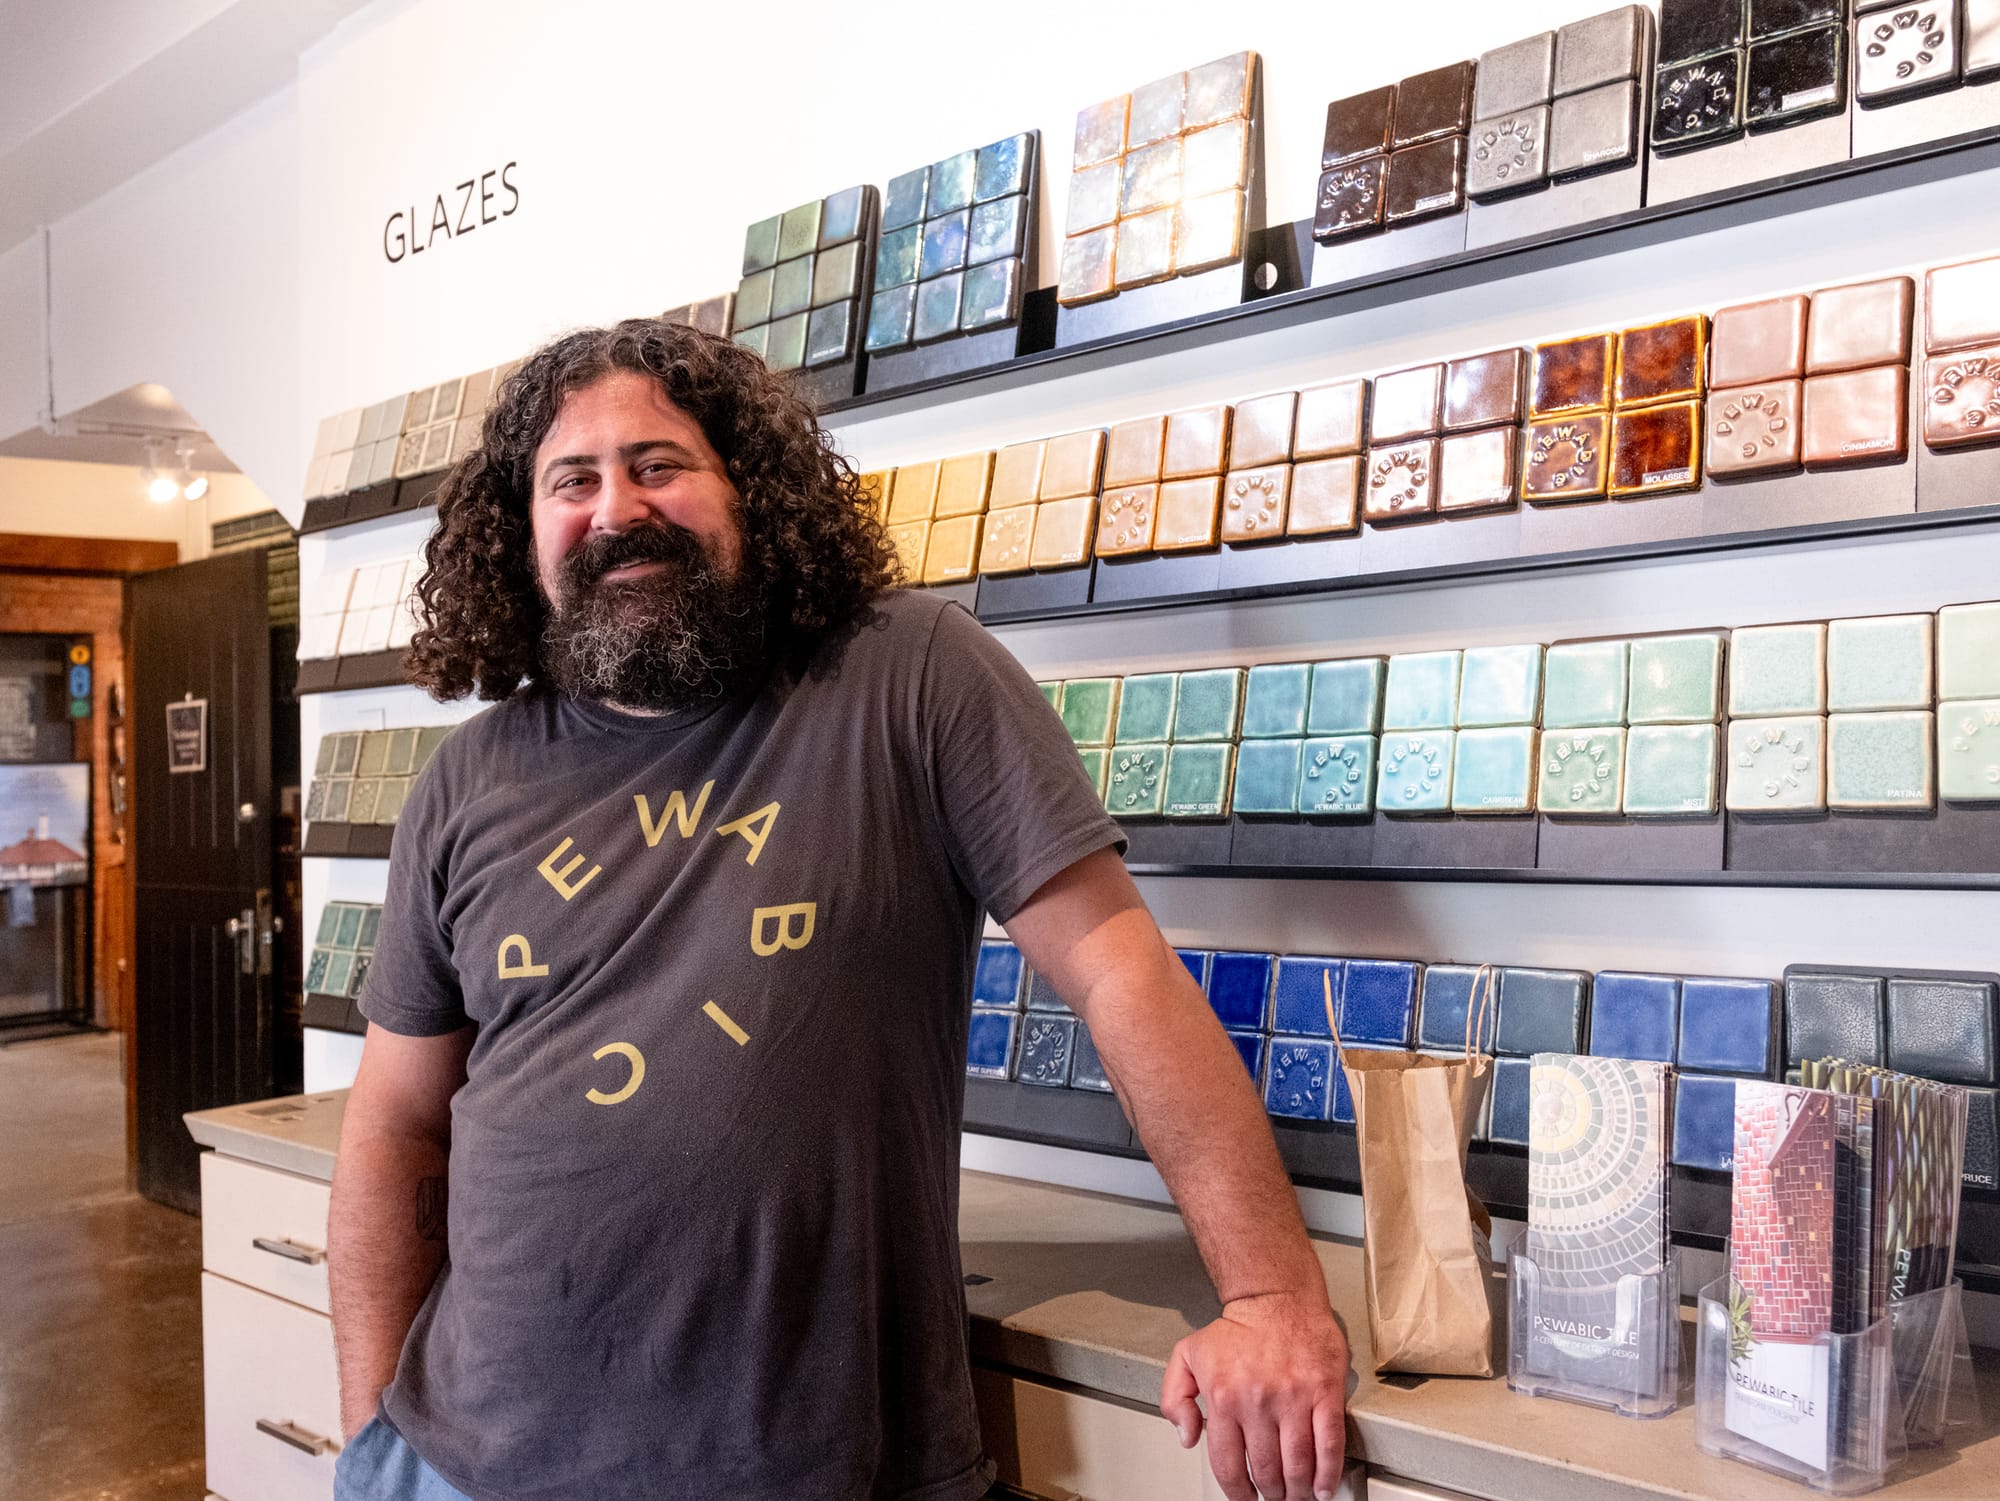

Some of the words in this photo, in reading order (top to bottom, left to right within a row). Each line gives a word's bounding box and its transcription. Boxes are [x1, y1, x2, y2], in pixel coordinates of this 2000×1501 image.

[384, 161, 519, 263] GLAZES
[1841, 439, 1894, 453] CINNAMON
[1644, 471, 1690, 485] MOLASSES
[1308, 744, 1360, 801] PEWABIC
[1888, 789, 1922, 799] PATINA
[1171, 803, 1197, 811] PEWABIC
[1314, 803, 1343, 811] PEWABIC
[1345, 803, 1362, 811] BLUE
[498, 780, 816, 1105] PEWABIC
[1961, 1173, 1993, 1185] RUCE
[1534, 1315, 1602, 1340] PEWABIC
[1606, 1327, 1638, 1346] TILE
[1791, 1393, 1815, 1417] TILE
